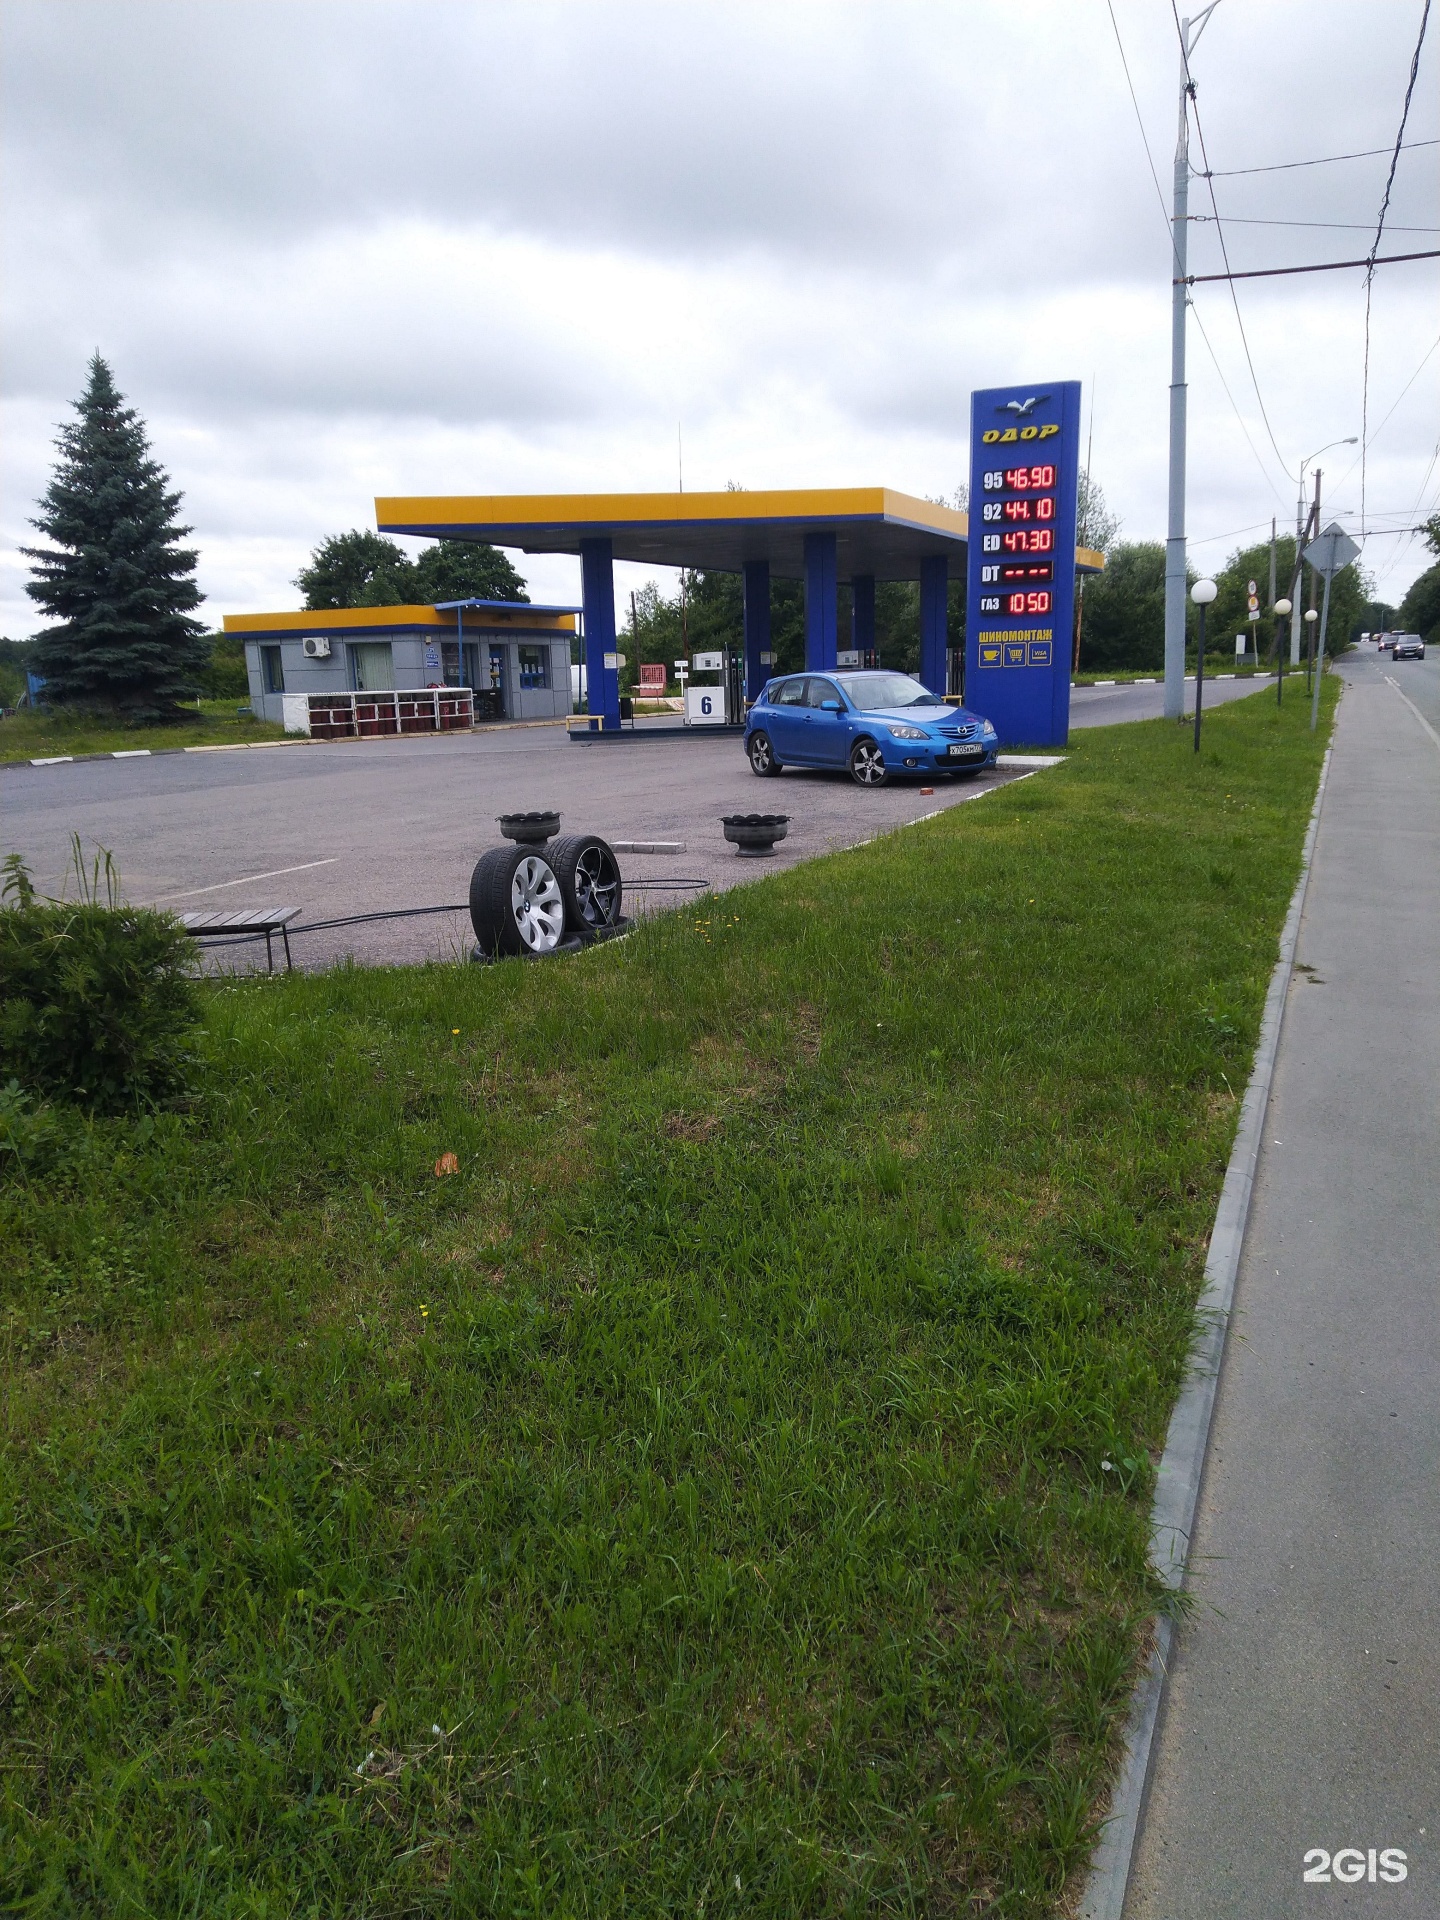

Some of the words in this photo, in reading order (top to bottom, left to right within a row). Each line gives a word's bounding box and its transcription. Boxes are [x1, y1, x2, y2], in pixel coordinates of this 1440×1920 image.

[982, 424, 1060, 443] ОДОР
[983, 471, 1003, 490] 95
[1006, 465, 1053, 489] 46.90
[983, 503, 1002, 521] 92
[983, 534, 1001, 552] ED
[1005, 529, 1051, 551] 47.30
[981, 565, 1000, 582] DT
[981, 598, 1000, 611] ГАЗ
[979, 629, 1053, 643] ШИНОМОНТАЖ
[701, 696, 712, 715] 6
